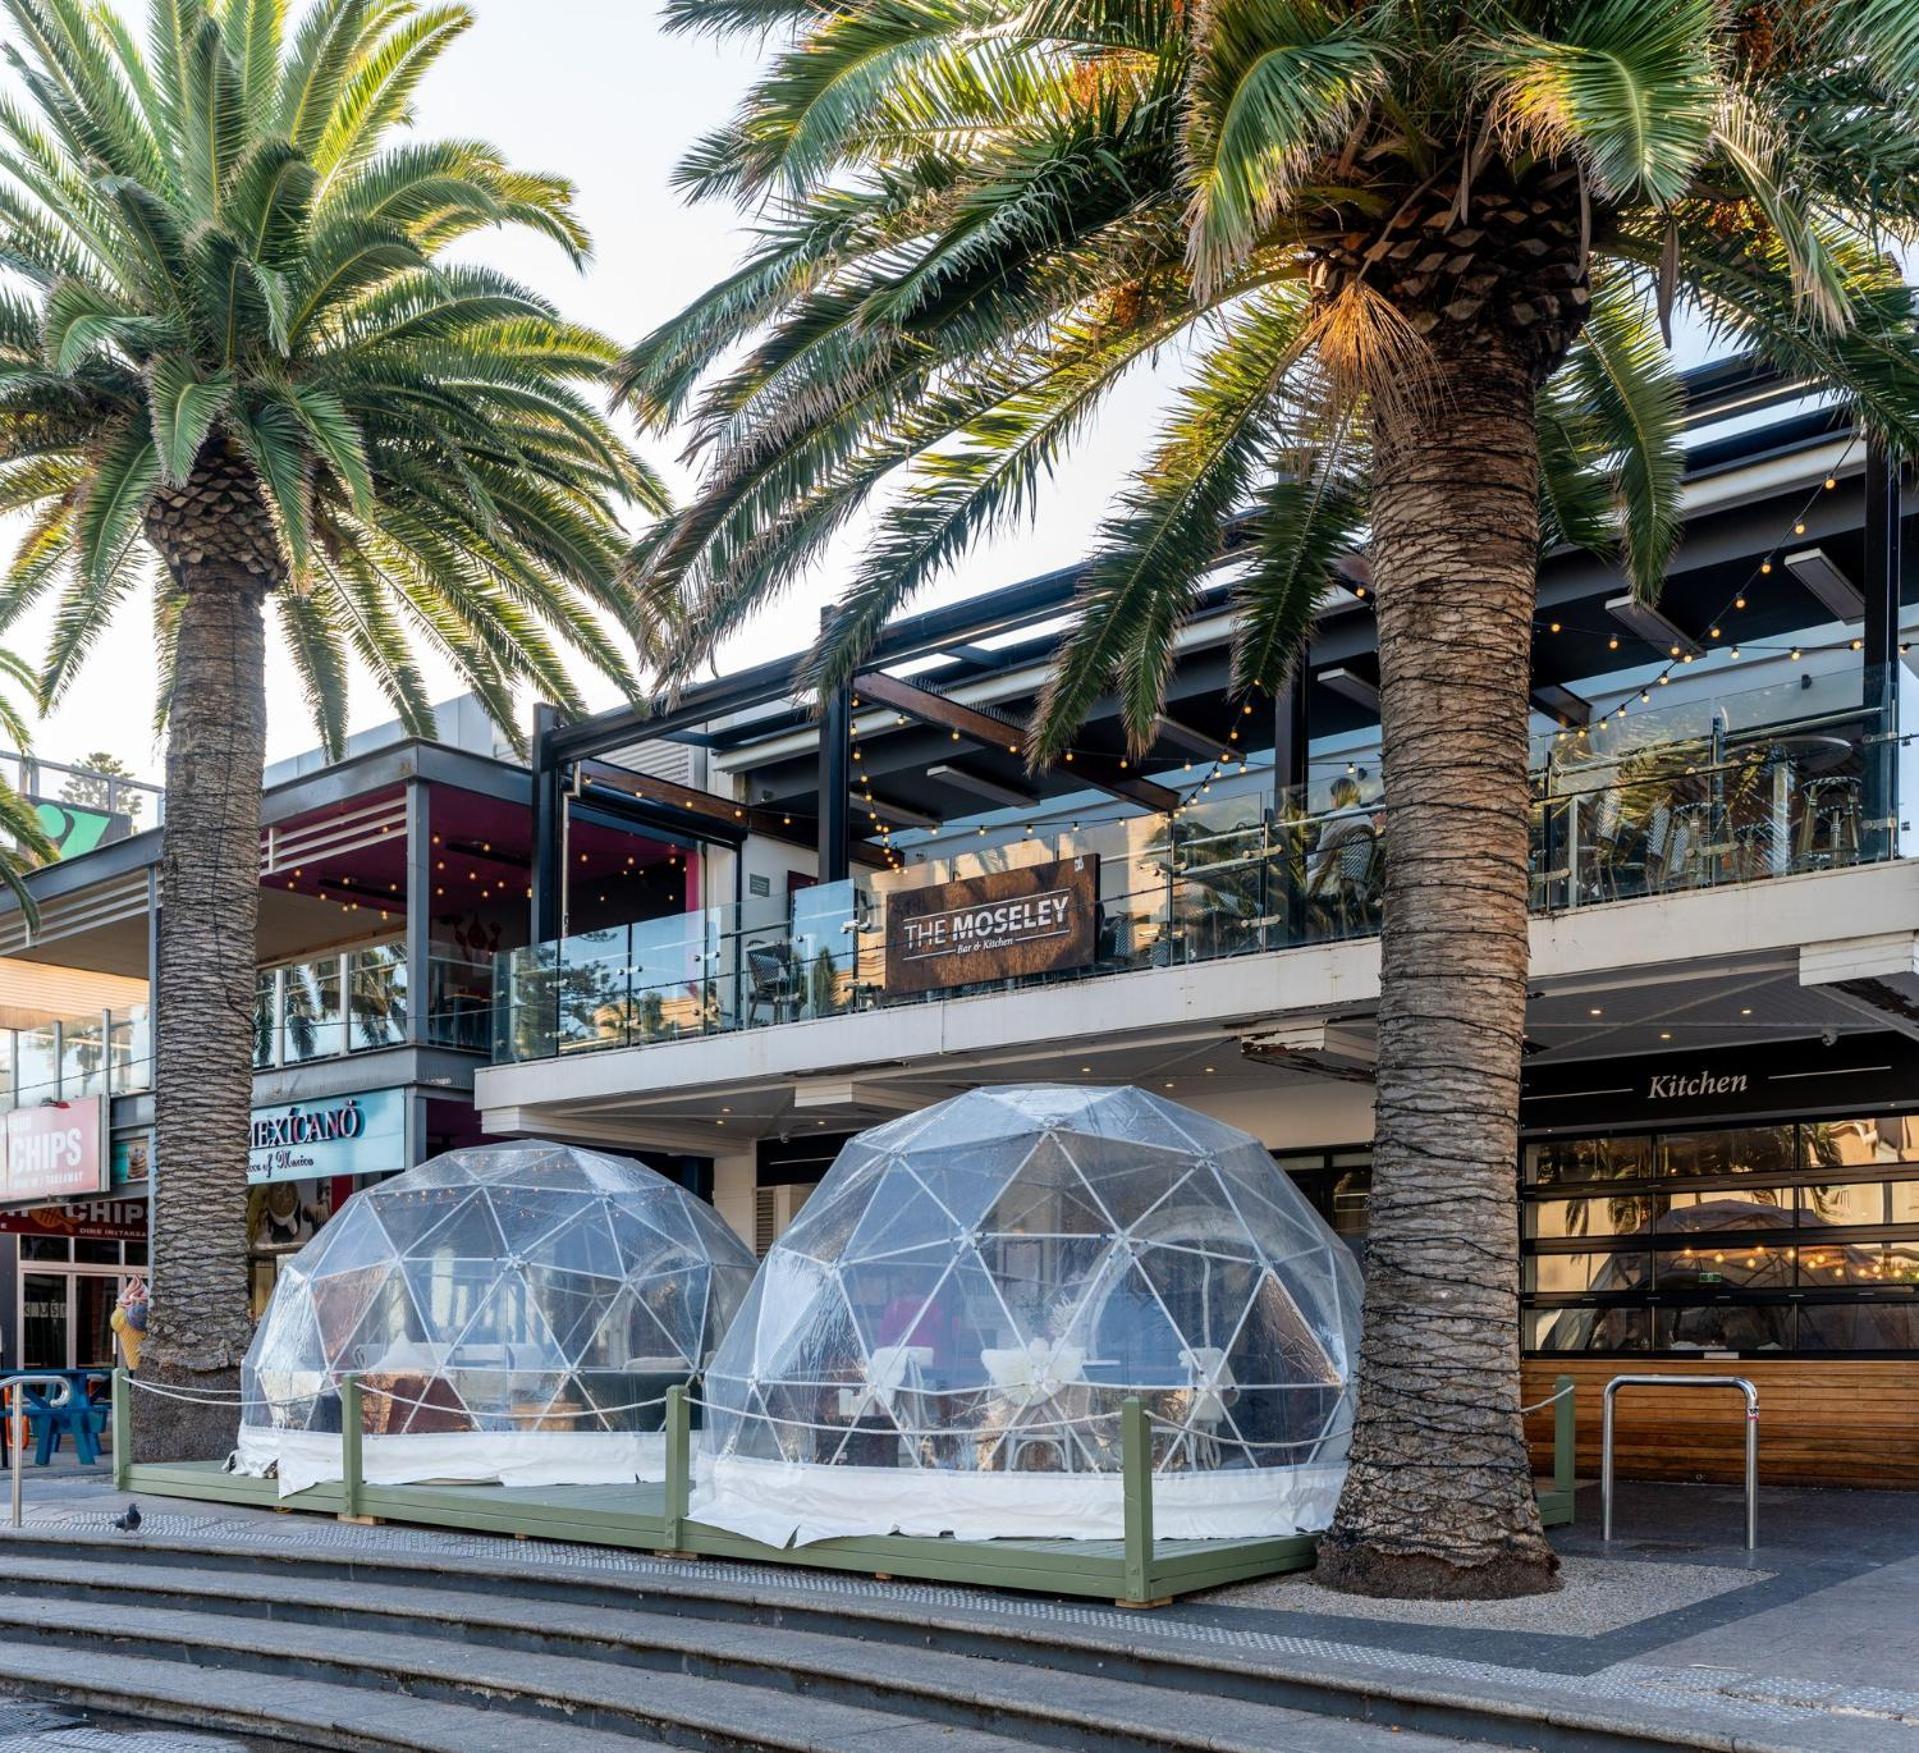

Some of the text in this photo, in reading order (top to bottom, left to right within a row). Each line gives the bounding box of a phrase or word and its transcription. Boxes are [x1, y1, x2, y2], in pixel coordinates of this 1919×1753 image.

[904, 896, 1069, 949] THE MOSELEY
[957, 937, 1014, 954] Bar & Kitchen
[1648, 1070, 1748, 1098] Kitchen
[10, 1127, 83, 1173] CHIPS
[262, 1153, 273, 1178] of
[65, 1200, 148, 1224] CHIP
